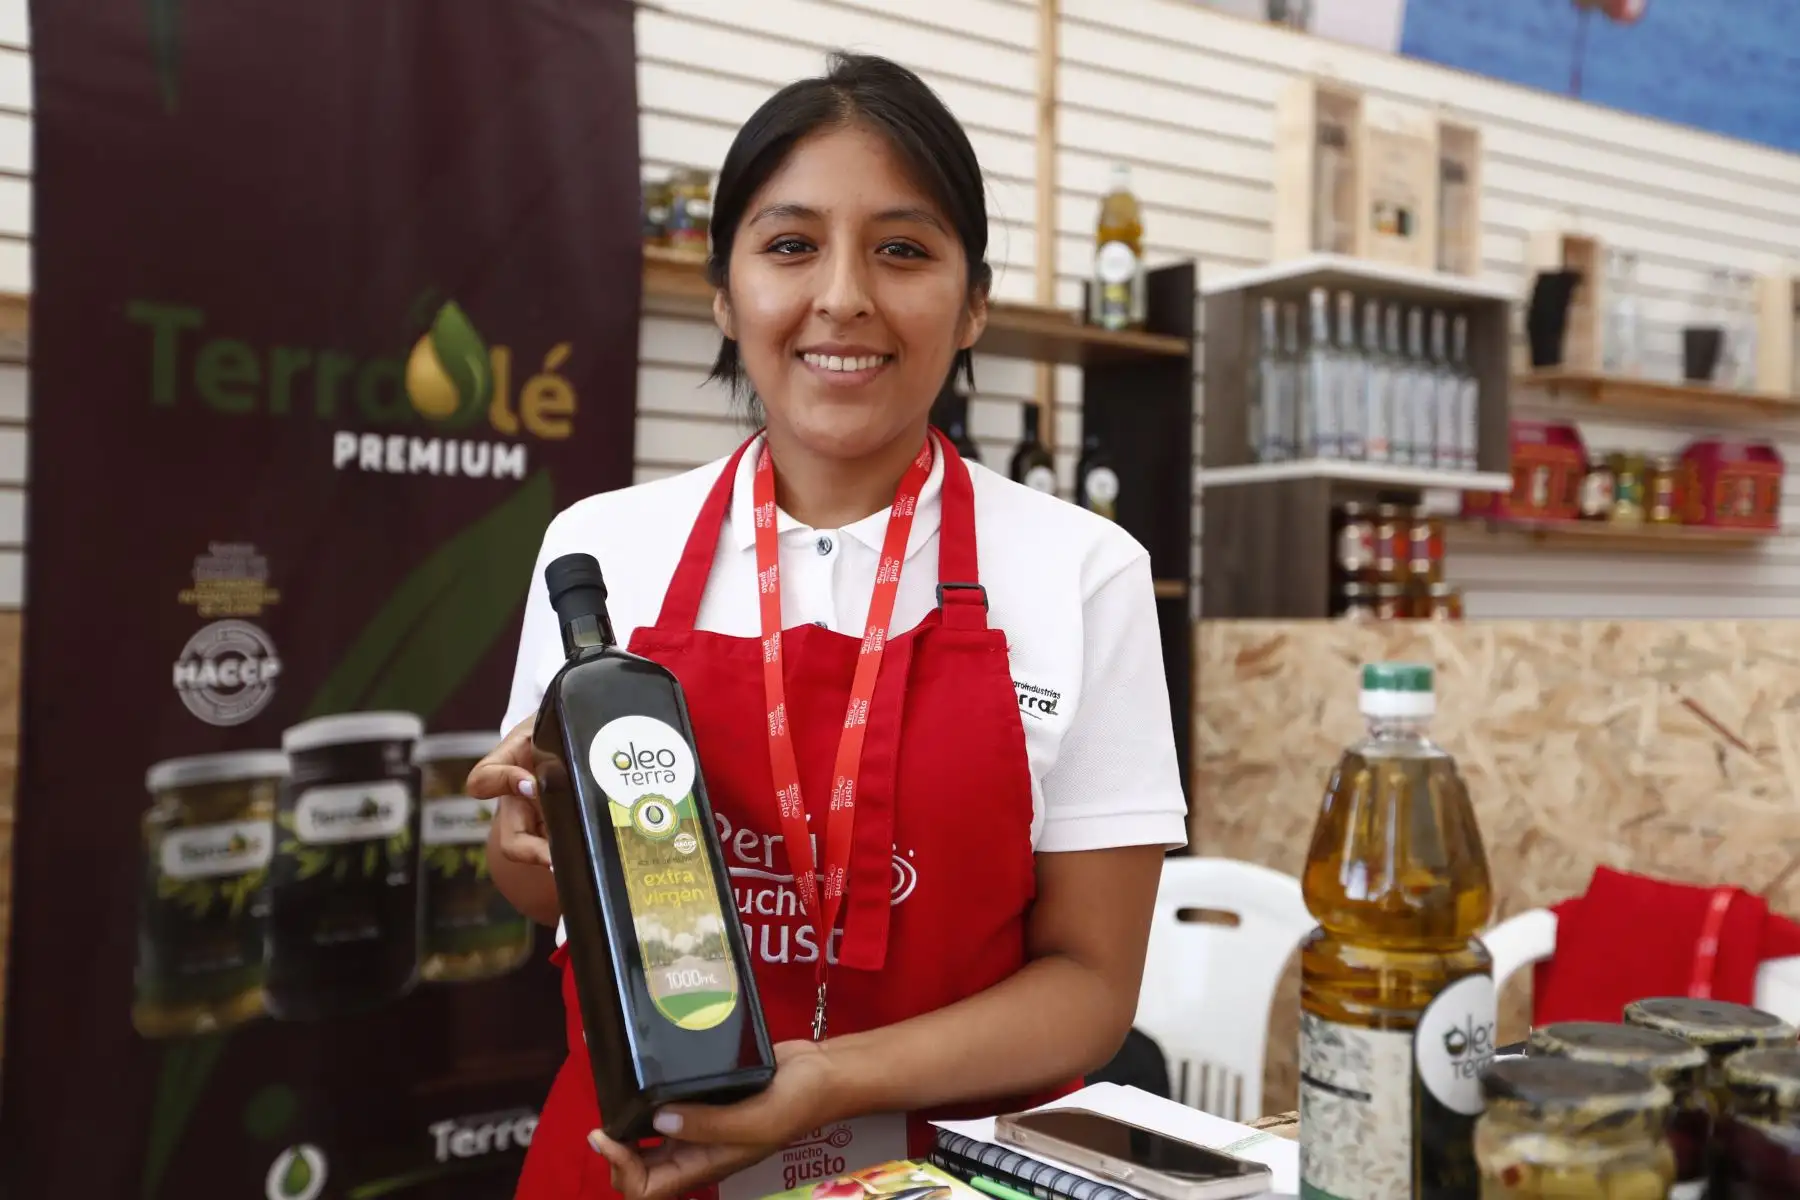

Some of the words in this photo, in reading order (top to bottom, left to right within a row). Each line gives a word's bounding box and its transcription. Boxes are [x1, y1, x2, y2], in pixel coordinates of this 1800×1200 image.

[333, 430, 528, 479] PREMIUM
[173, 655, 282, 690] HACCP
[858, 700, 868, 725] gusto
[611, 741, 676, 771] oleo
[619, 769, 676, 786] Terra
[776, 790, 789, 817] gusto
[844, 779, 854, 808] gusto
[643, 868, 695, 887] extra
[834, 867, 844, 897] gusto
[643, 888, 705, 908] virgen
[783, 1147, 823, 1162] mucho
[783, 1153, 846, 1190] gusto
